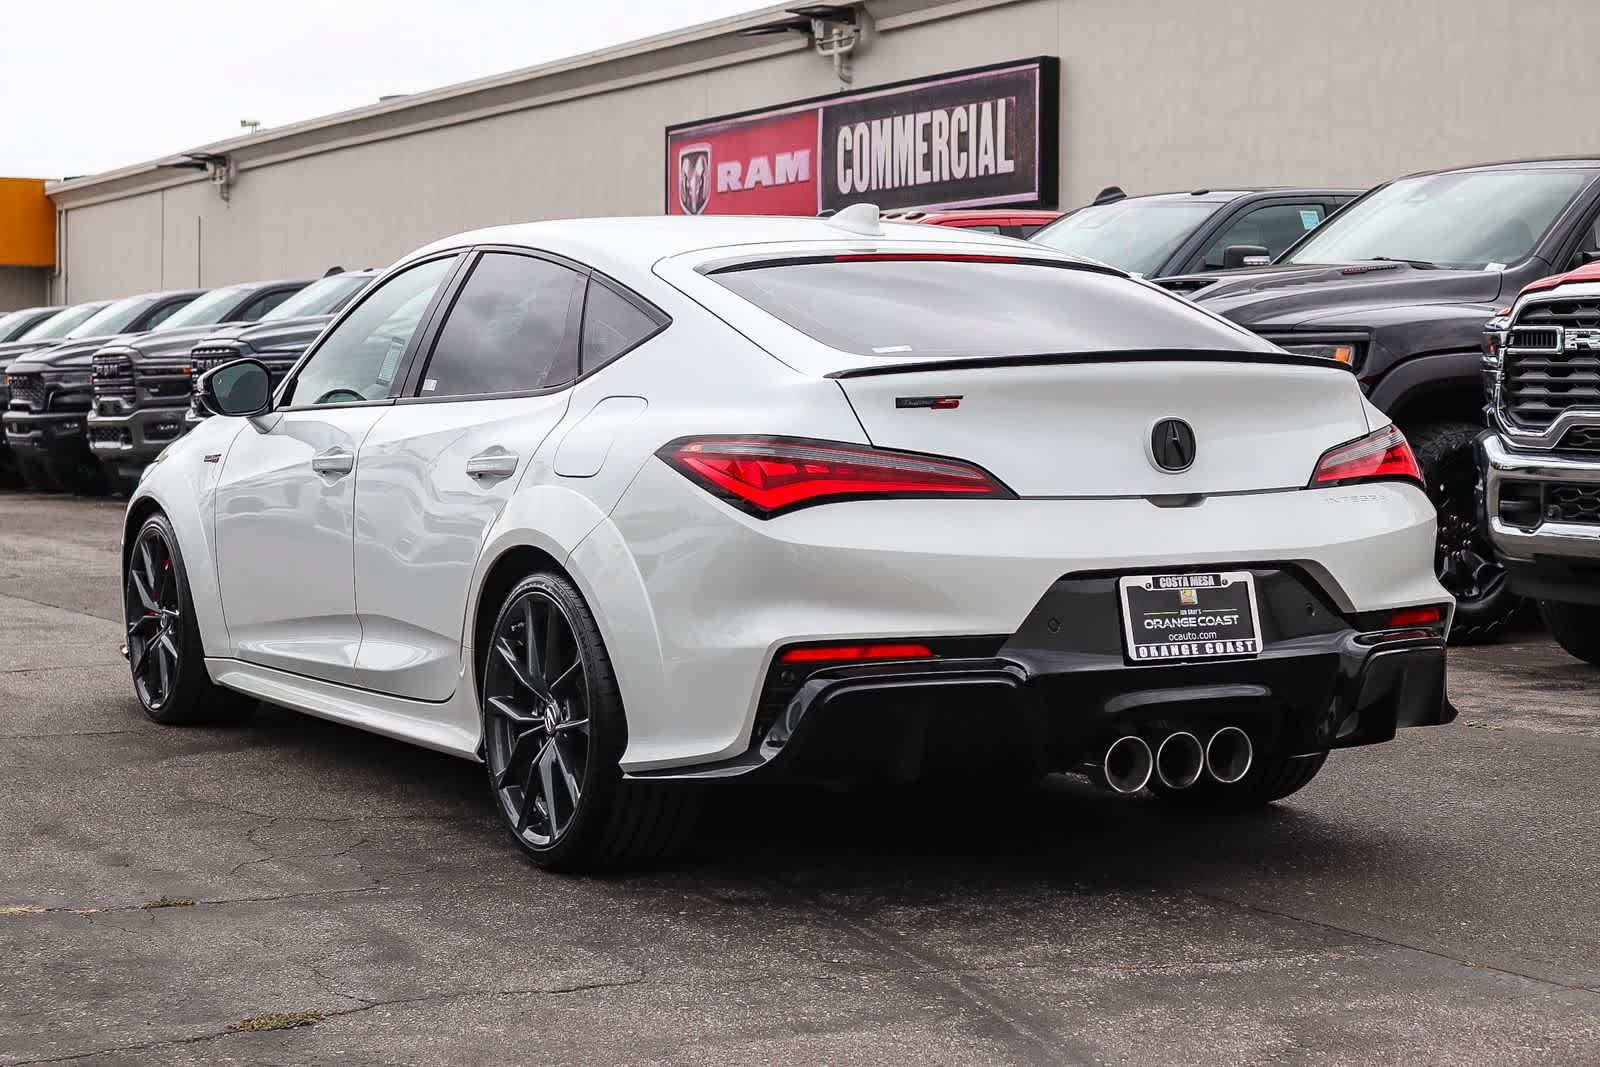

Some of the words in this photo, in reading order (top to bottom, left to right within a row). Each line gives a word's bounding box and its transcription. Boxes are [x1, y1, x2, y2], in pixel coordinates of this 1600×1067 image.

[837, 97, 1015, 194] COMMERCIAL
[717, 149, 811, 193] RAM
[1159, 576, 1189, 588] COSTA
[1190, 575, 1215, 586] MESA
[1144, 616, 1197, 629] ORANGE
[1198, 614, 1239, 627] COAST
[1168, 631, 1217, 641] ocauto.com
[1139, 643, 1199, 658] ORANGE
[1205, 640, 1254, 654] COAST
